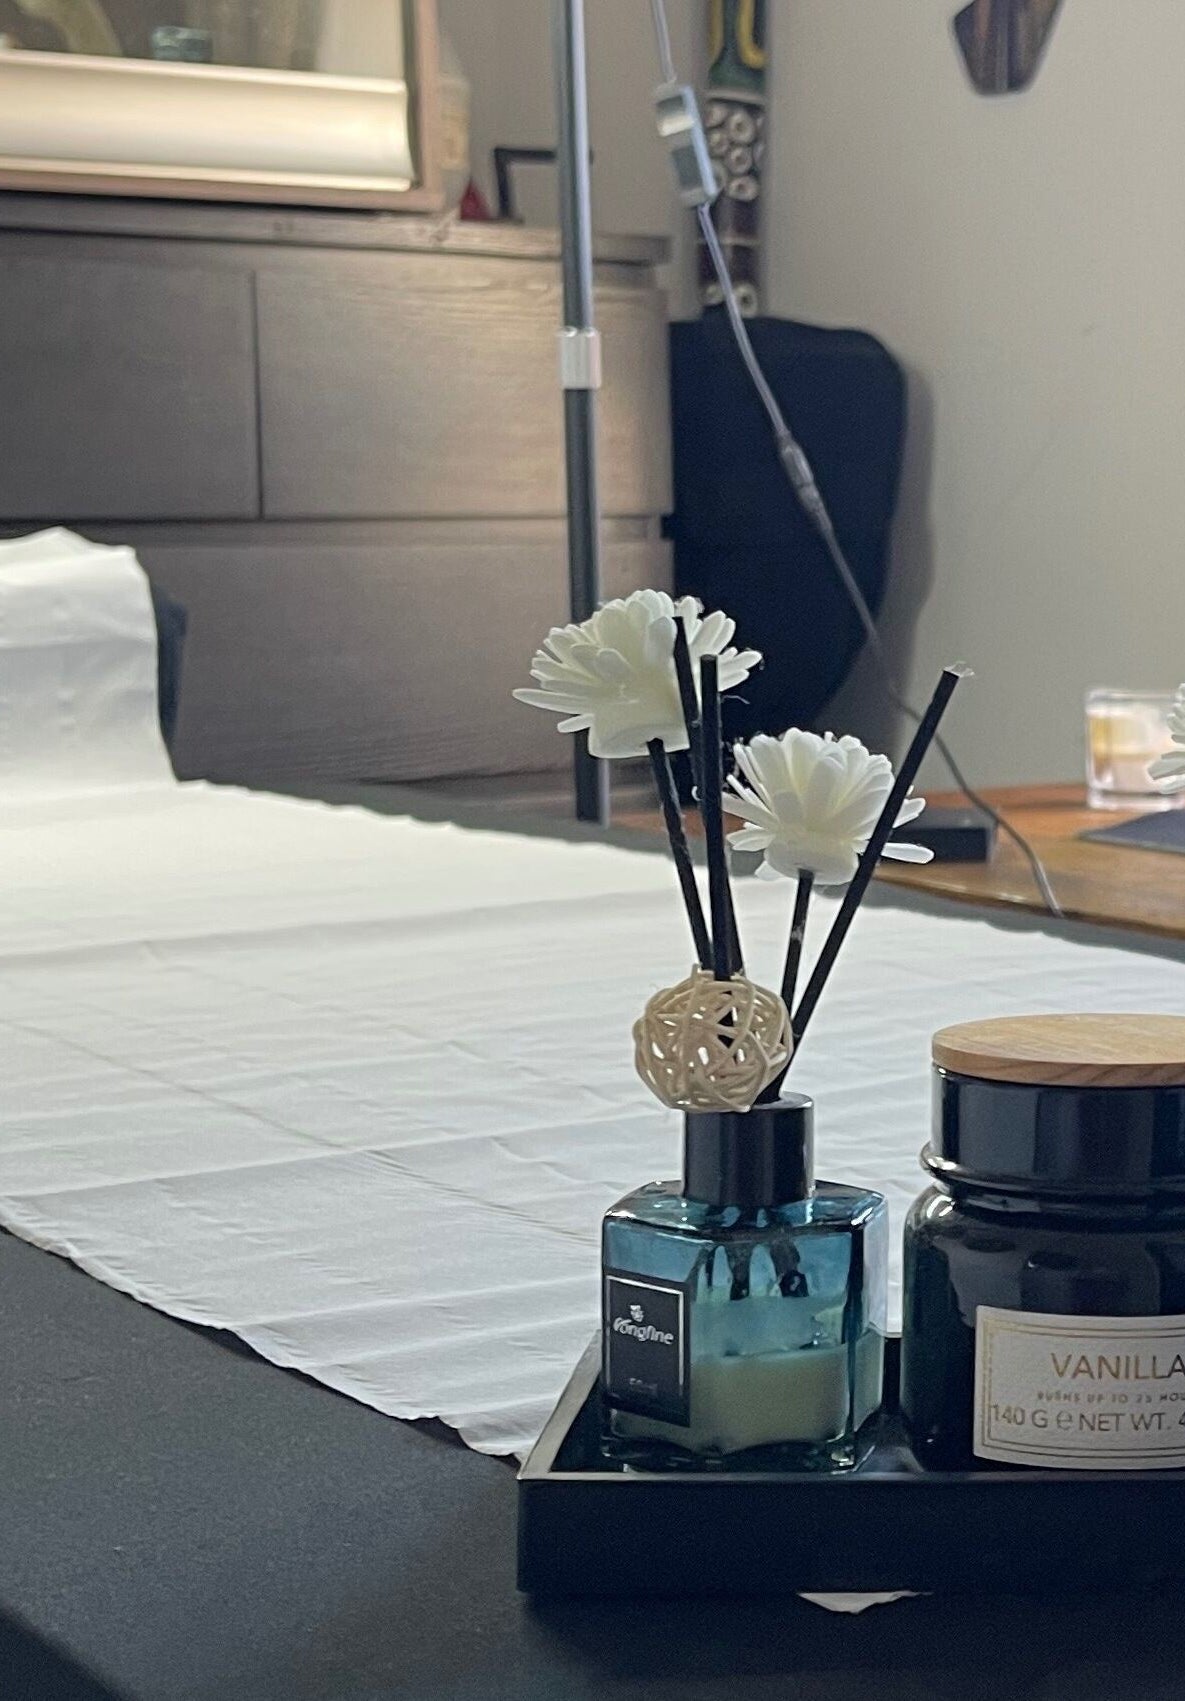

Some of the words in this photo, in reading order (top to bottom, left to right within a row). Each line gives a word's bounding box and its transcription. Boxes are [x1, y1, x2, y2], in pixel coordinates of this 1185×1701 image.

[990, 1404, 1026, 1426] 140
[1031, 1408, 1048, 1429] G
[1079, 1412, 1125, 1432] NET
[1130, 1412, 1172, 1431] WT.
